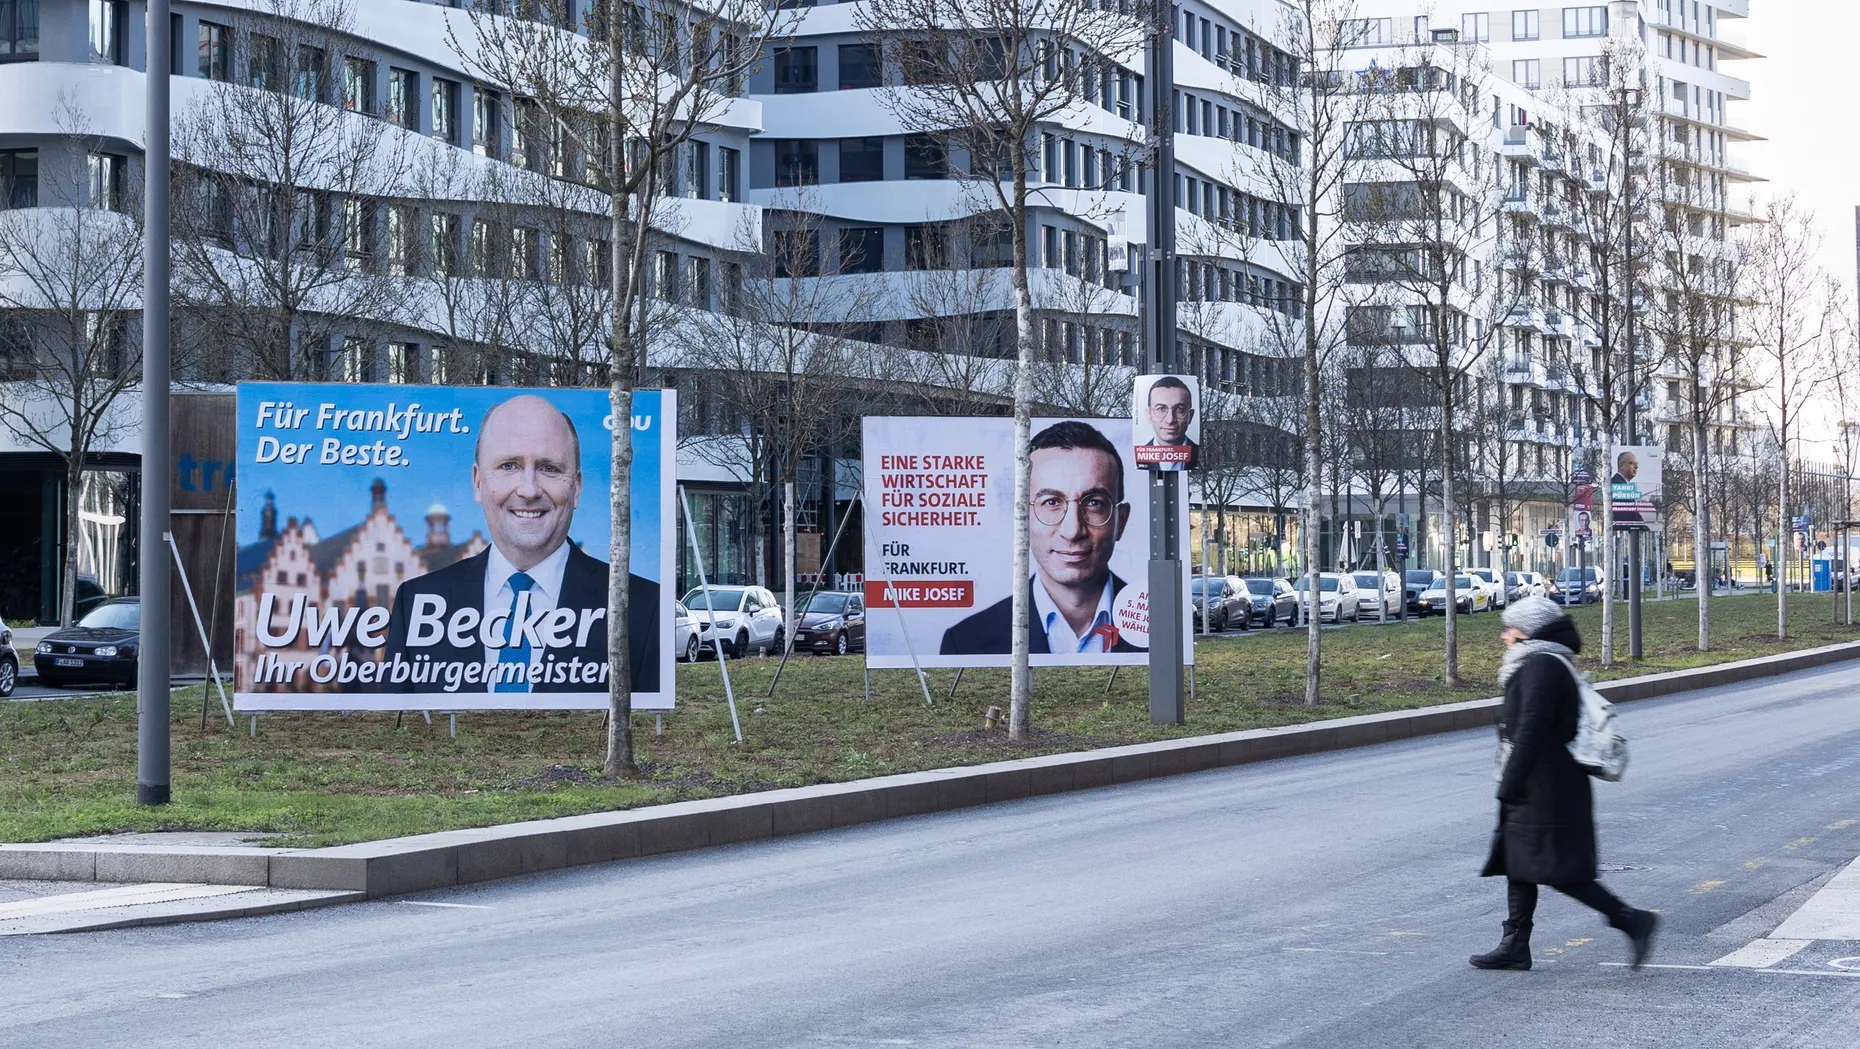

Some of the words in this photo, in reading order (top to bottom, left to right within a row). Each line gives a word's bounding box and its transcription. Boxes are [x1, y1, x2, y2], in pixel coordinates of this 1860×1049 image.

[256, 401, 309, 430] Für
[316, 403, 470, 440] Frankfurt.
[603, 415, 651, 431] CU
[255, 436, 313, 464] Der
[320, 438, 410, 466] Beste.
[881, 455, 918, 470] EINE
[922, 455, 985, 470] STARKE
[881, 474, 988, 489] WIRTSCHAFT
[882, 489, 914, 507] FÜR
[918, 493, 985, 508] SOZIALE
[882, 511, 981, 526] SICHERHEIT.
[882, 541, 910, 557] FÜR
[883, 588, 920, 601] MIKE
[923, 588, 965, 601] JOSEF
[256, 593, 391, 648] Uwe
[405, 590, 607, 649] Becker
[1118, 608, 1141, 621] MIKE
[253, 653, 303, 684] Ihr
[309, 653, 610, 692] Oberbürgermeister
